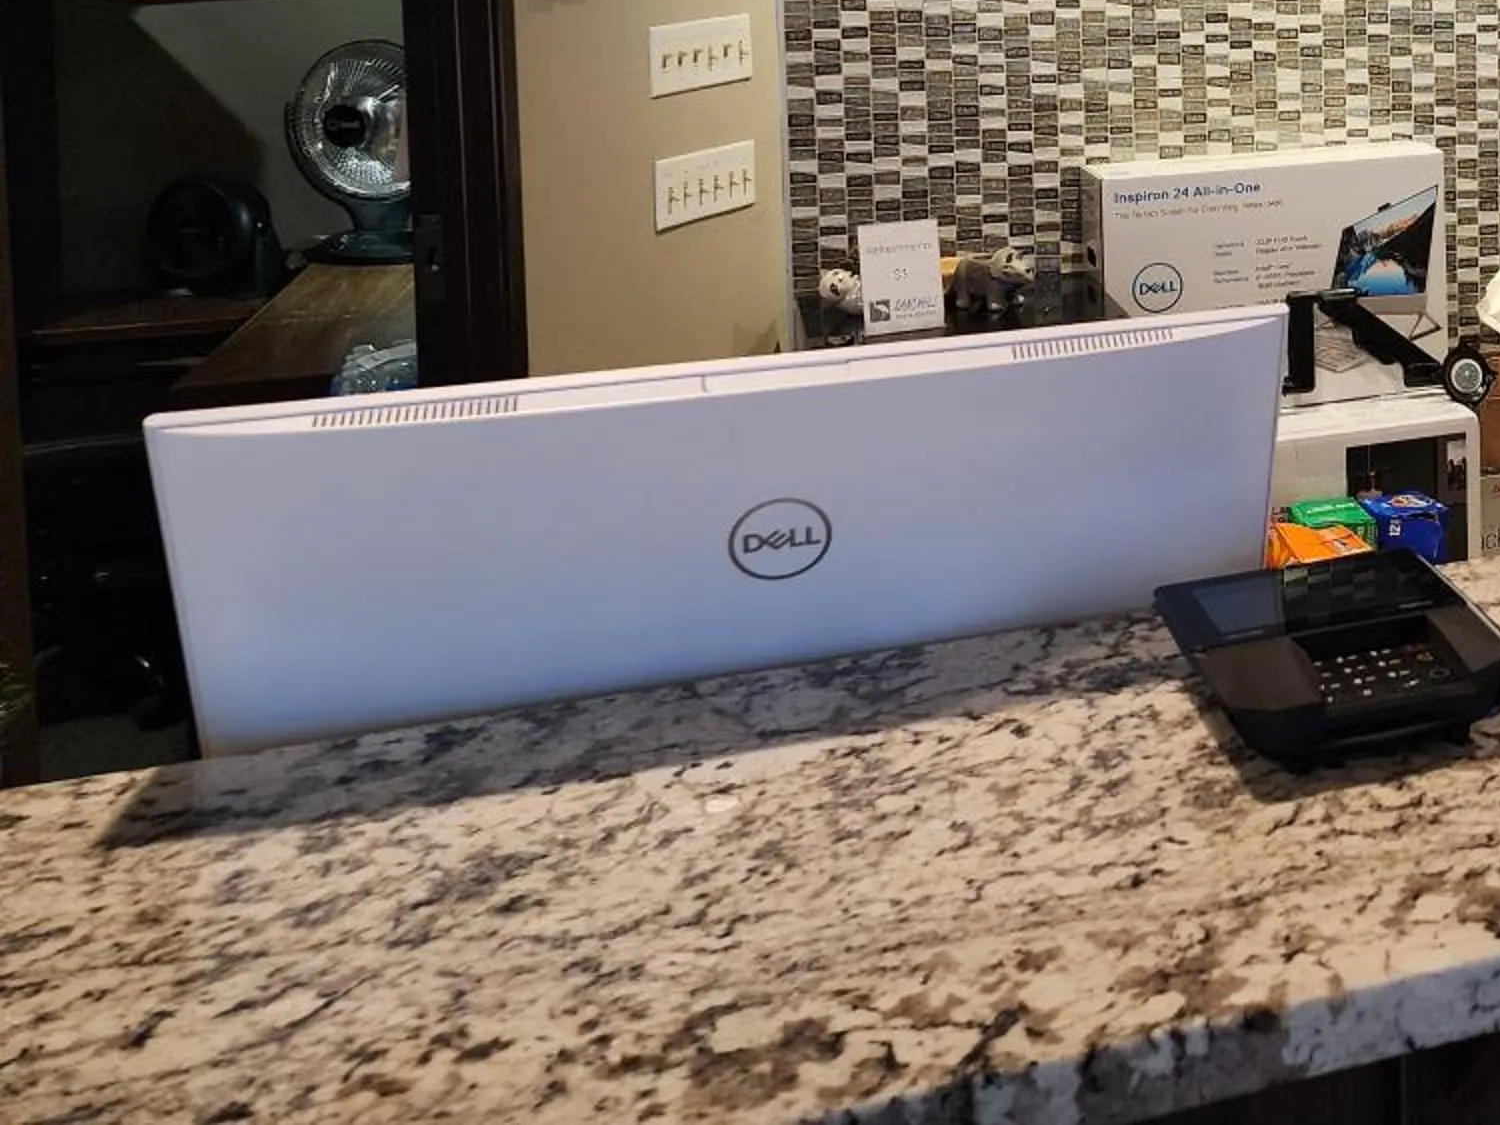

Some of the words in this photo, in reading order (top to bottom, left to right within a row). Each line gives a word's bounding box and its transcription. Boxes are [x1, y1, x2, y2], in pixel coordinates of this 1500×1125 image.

[1114, 189, 1170, 205] Inspiron
[1173, 186, 1189, 200] 24
[1193, 182, 1261, 197] All-in-One
[1139, 280, 1179, 296] DELL
[742, 526, 822, 554] DELL
